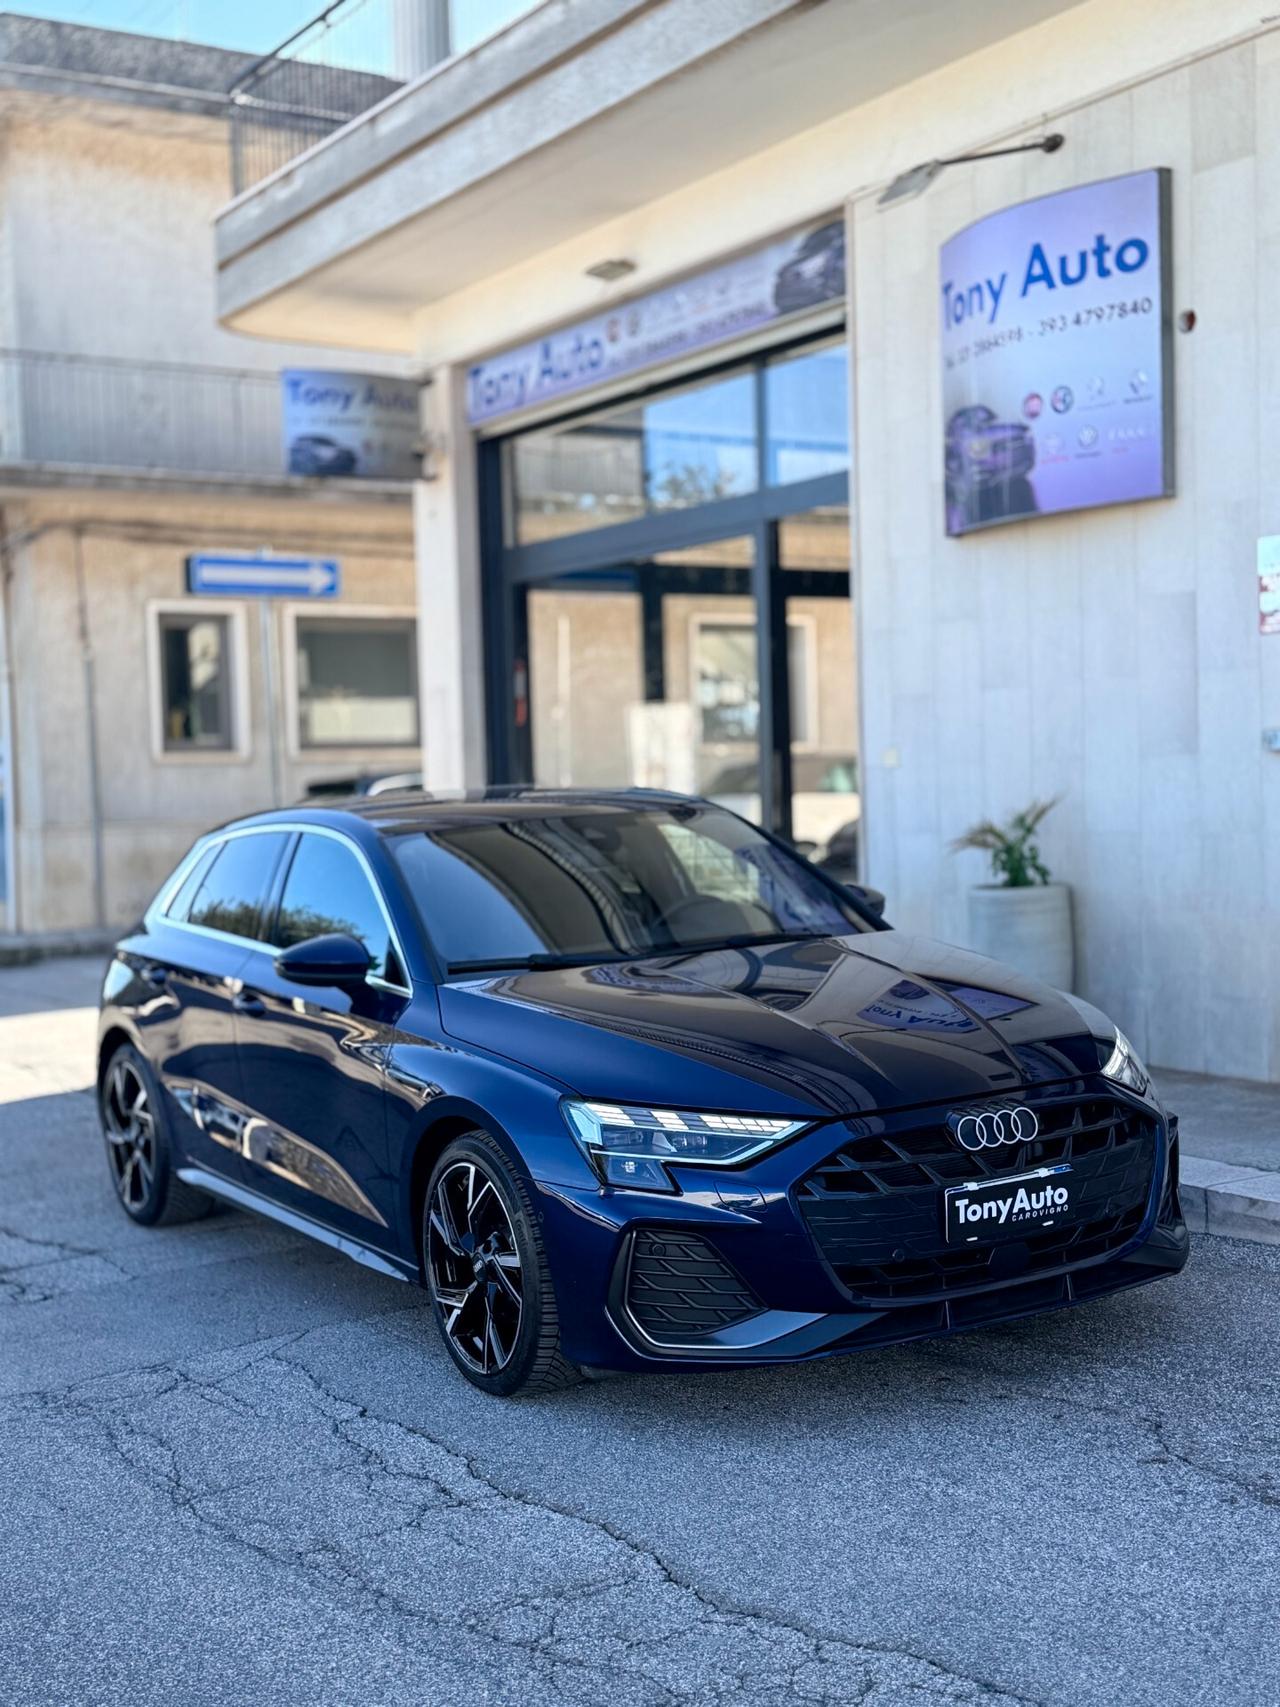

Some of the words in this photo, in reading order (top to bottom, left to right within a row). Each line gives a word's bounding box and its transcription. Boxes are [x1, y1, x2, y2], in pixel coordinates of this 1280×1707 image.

[943, 272, 1006, 331] Tony
[1020, 233, 1149, 298] Auto
[469, 366, 530, 409] Tony
[537, 335, 604, 391] Auto
[287, 378, 354, 412] Tony
[955, 1185, 1069, 1224] TonyAuto
[1011, 1204, 1069, 1222] CAROVIGNO
